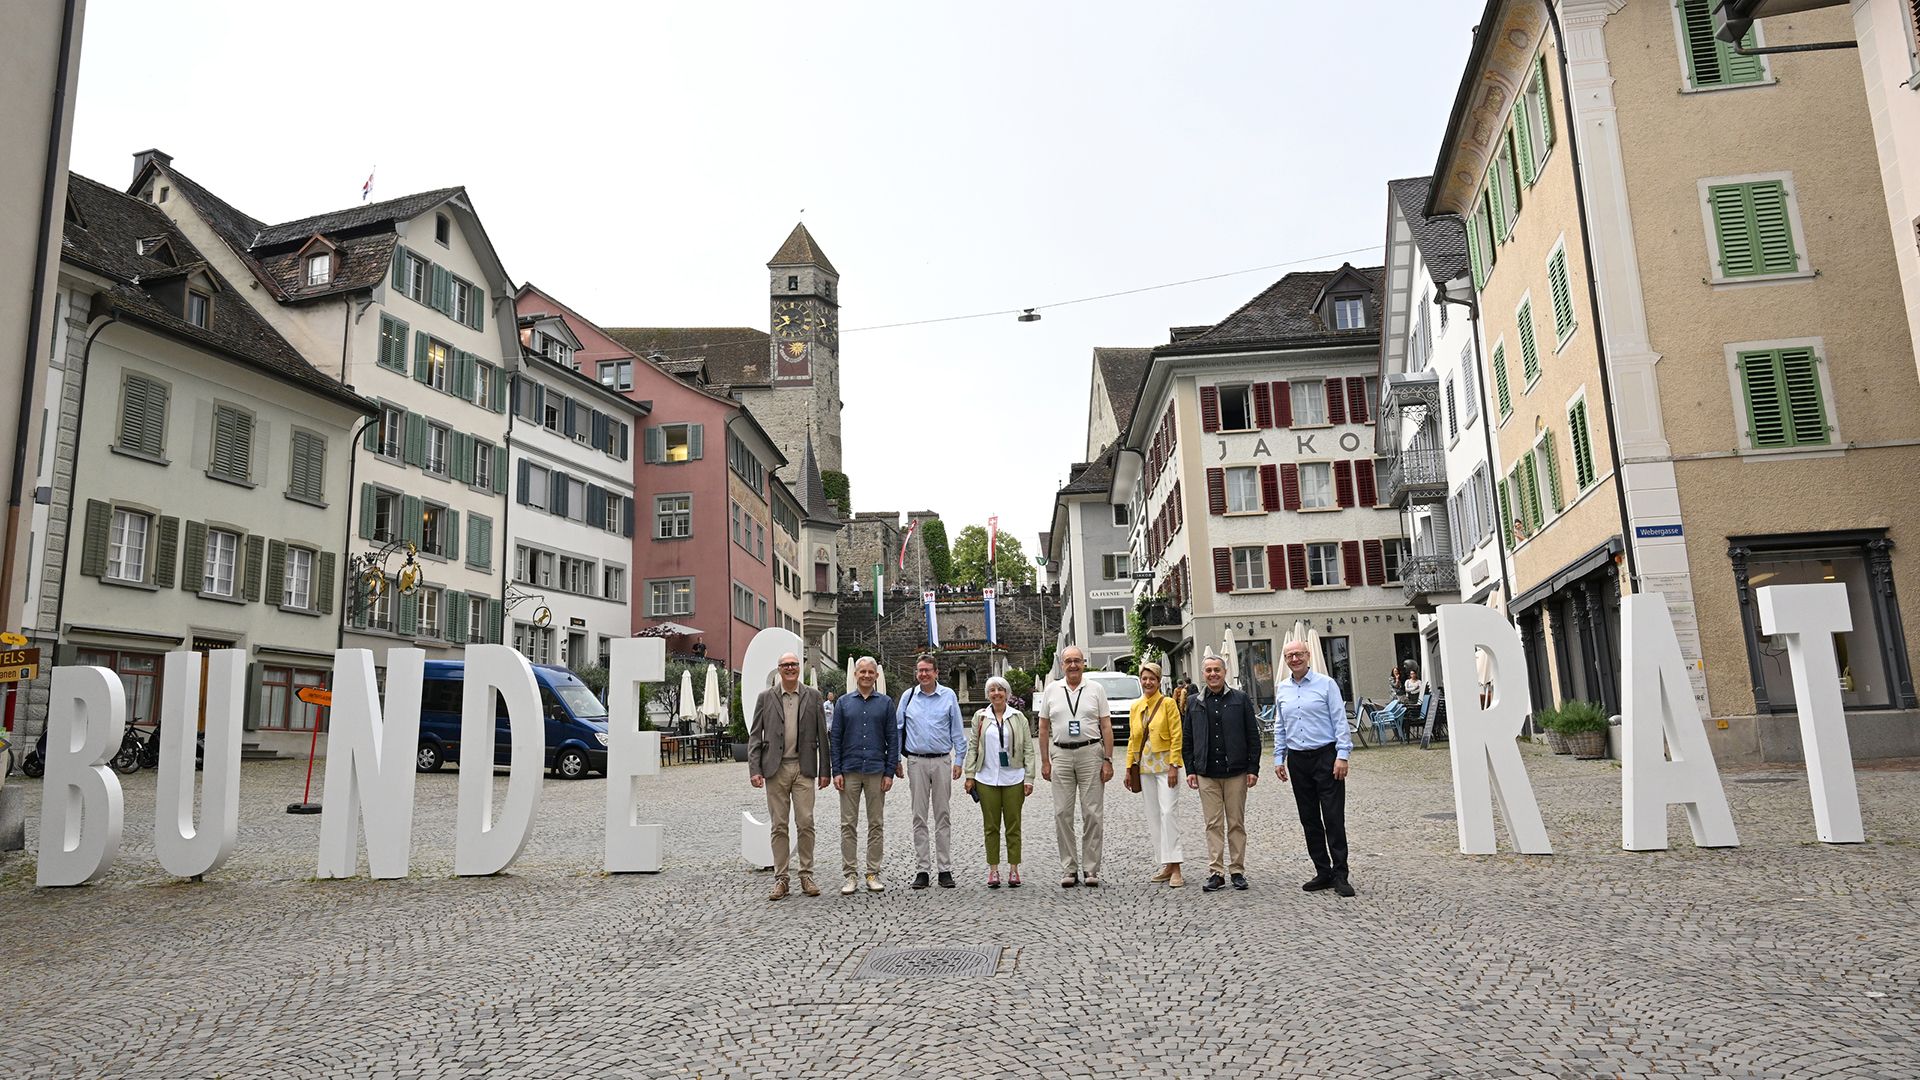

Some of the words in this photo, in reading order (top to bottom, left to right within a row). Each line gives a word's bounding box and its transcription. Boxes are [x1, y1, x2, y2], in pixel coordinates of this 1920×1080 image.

[1218, 432, 1360, 461] JAKO
[1640, 528, 1679, 536] Webergasse
[1224, 620, 1278, 629] HOTEL
[1326, 614, 1417, 624] HAUPTPLA
[1436, 582, 1866, 856] RAT
